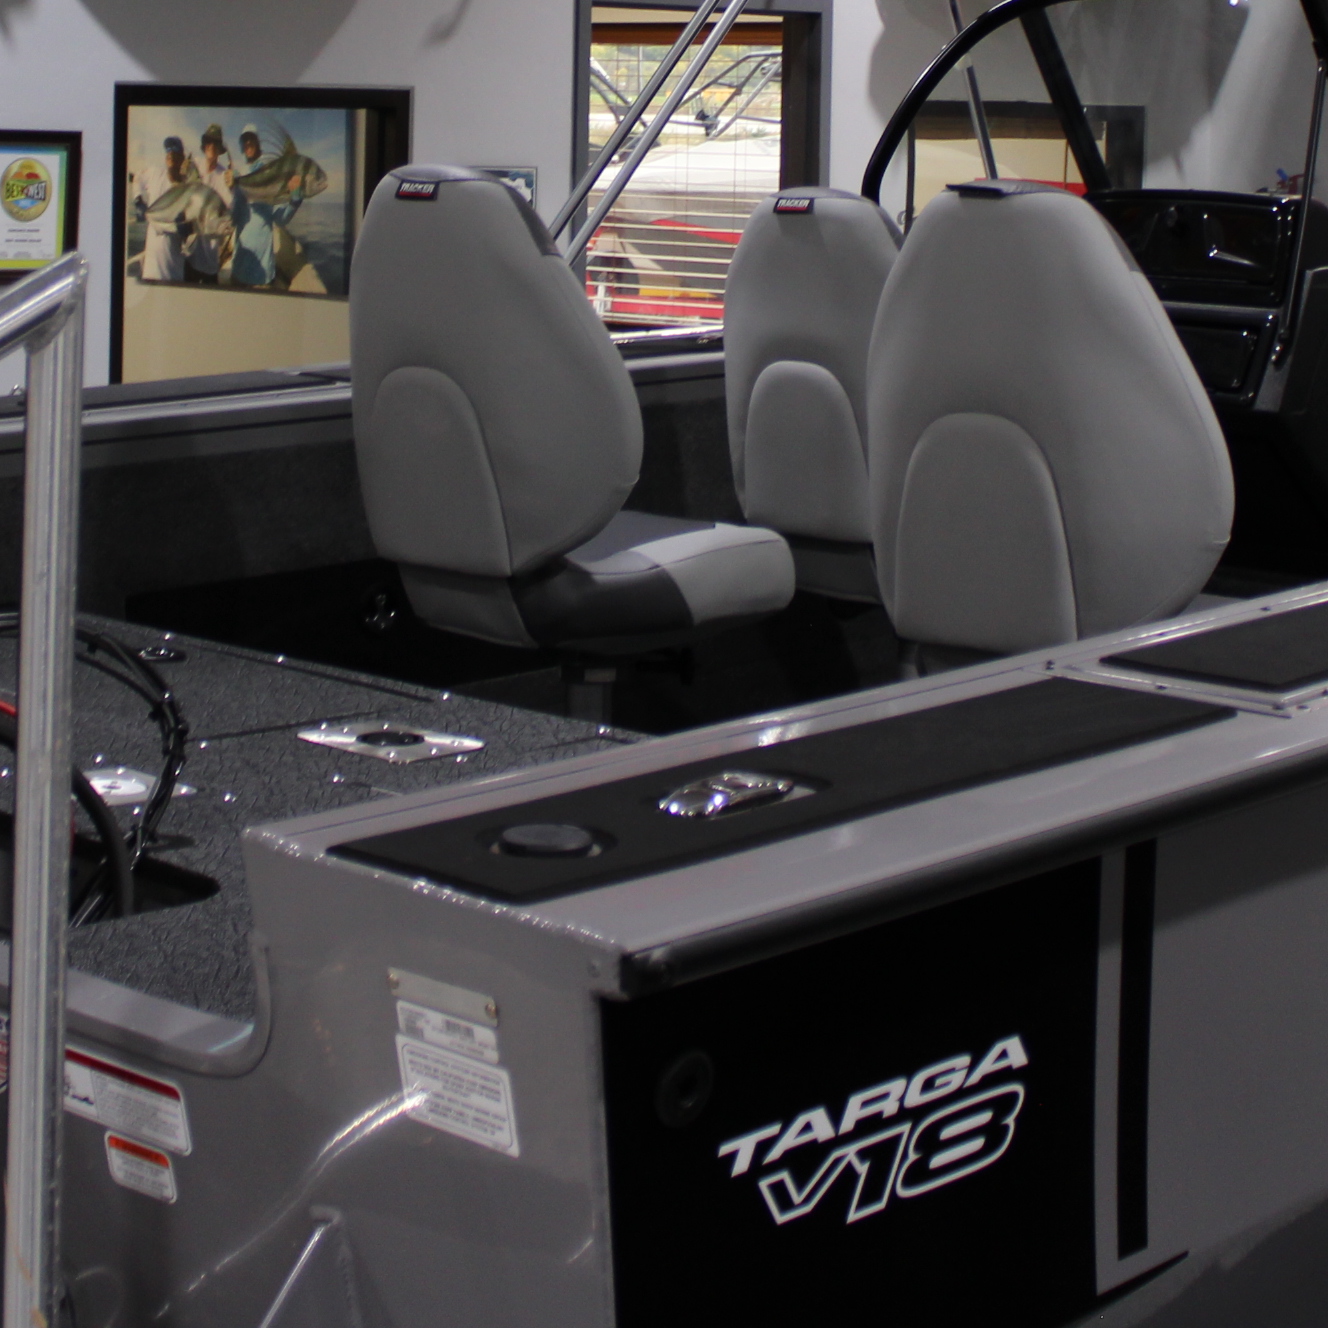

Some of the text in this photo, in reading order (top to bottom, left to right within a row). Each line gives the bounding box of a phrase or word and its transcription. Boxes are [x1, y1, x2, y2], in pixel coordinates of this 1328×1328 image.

[398, 180, 437, 196] TRACKER
[776, 198, 812, 212] TRACKER
[716, 1034, 1029, 1177] TARGA
[758, 1082, 1026, 1225] V18
